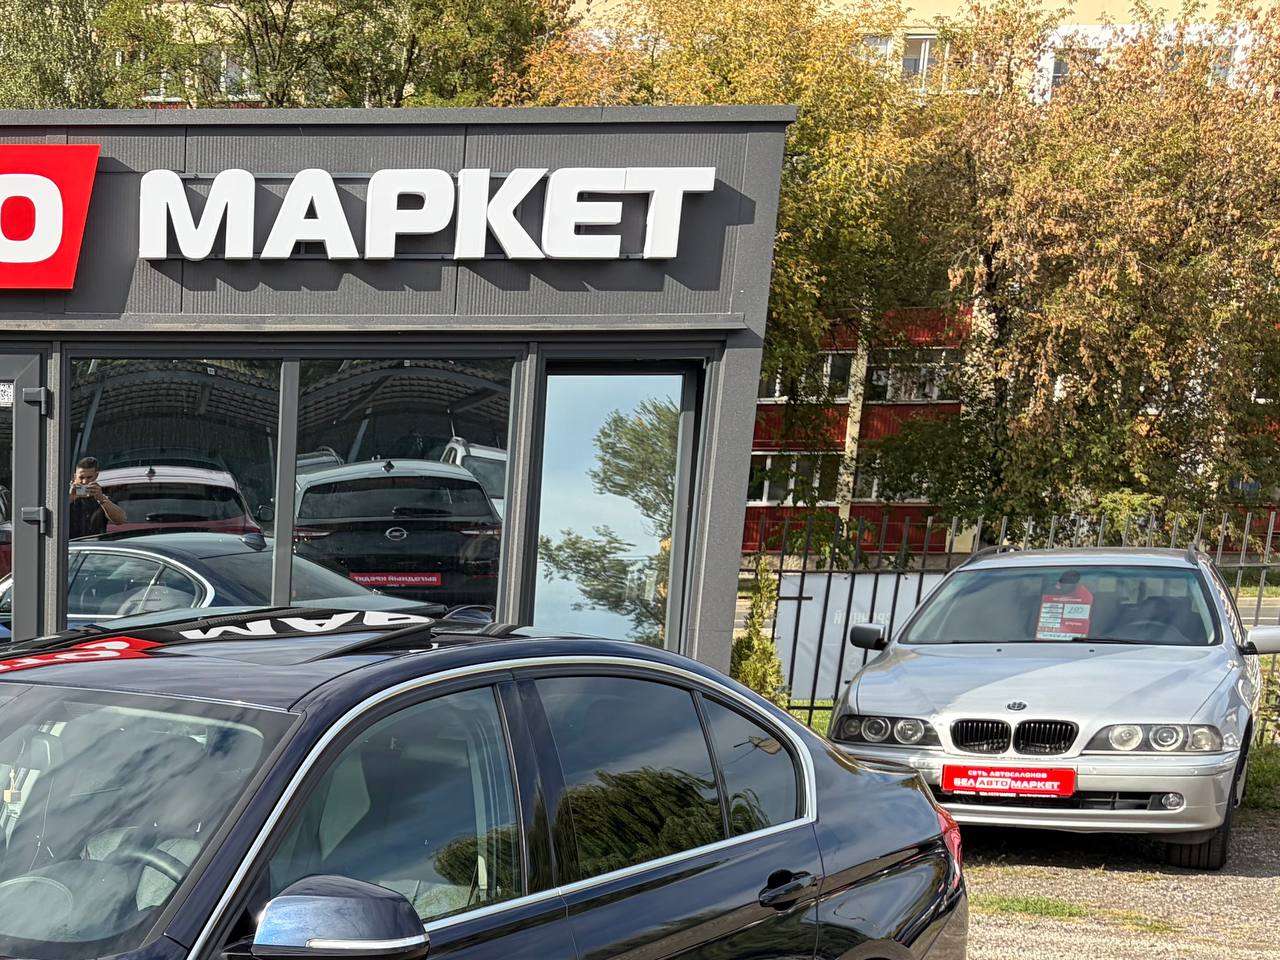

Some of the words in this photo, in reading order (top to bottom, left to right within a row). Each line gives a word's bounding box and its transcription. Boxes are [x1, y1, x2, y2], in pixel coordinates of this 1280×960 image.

[138, 167, 716, 262] МАРКЕТ
[967, 769, 988, 777] СЕТЬ
[989, 770, 1048, 779] АВТОСАЛОНОВ
[977, 778, 1009, 788] АВТО
[1010, 779, 1060, 790] МАРКЕТ
